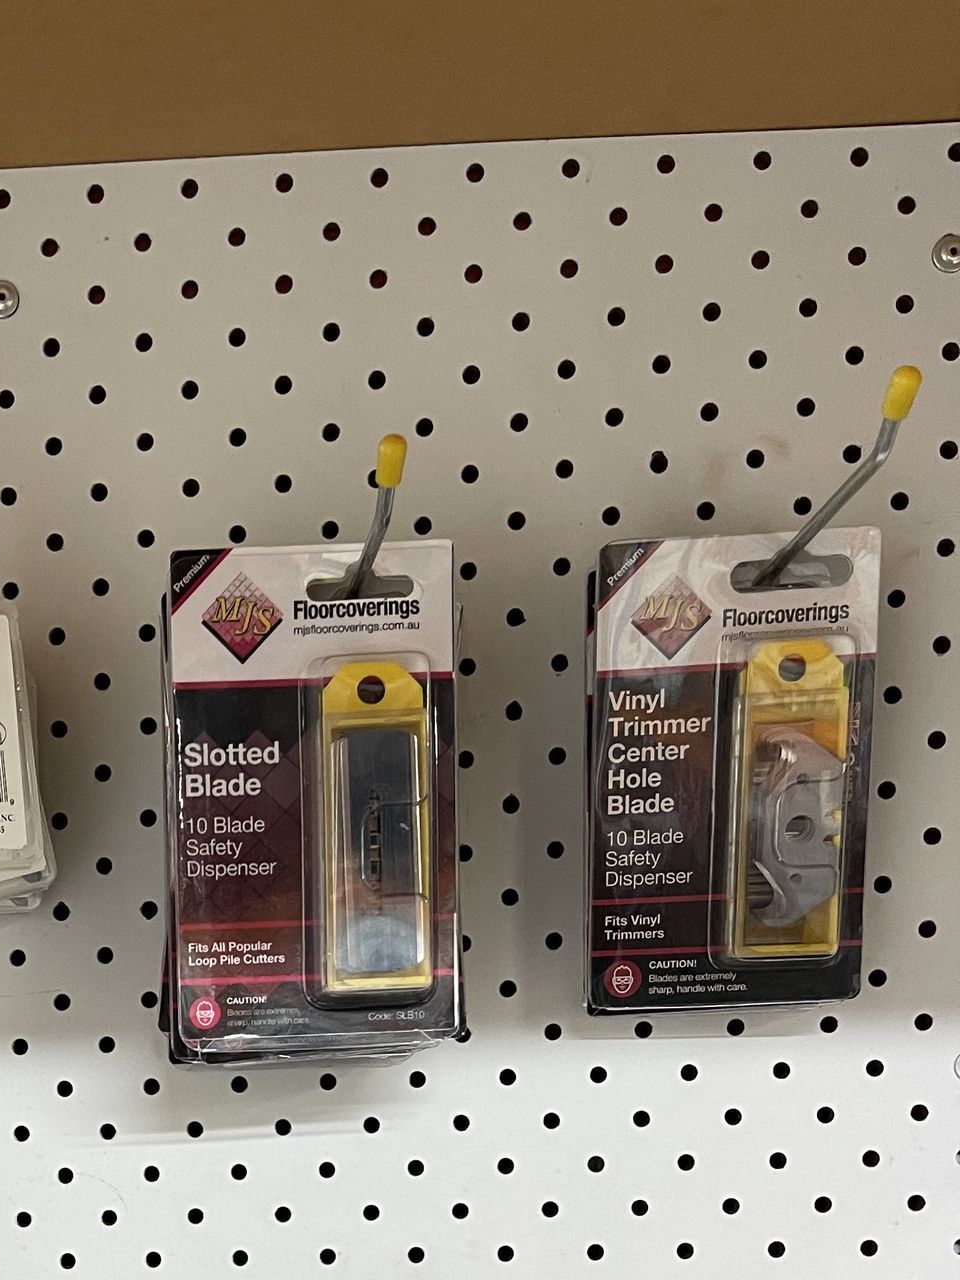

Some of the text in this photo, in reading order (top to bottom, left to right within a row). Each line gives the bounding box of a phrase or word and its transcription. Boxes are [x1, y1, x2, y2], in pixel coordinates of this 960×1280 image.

[173, 555, 211, 592] Premium
[607, 547, 644, 586] Premium
[212, 596, 276, 635] MJS
[294, 598, 420, 619] Floorcoverings
[640, 593, 703, 631] MJS
[722, 602, 849, 627] Floorcoverings
[294, 621, 420, 636] mjsfloorcoverings.com.au
[609, 688, 665, 713] Vinyl
[608, 716, 711, 737] Trimmer
[184, 741, 280, 767] Slotted
[608, 743, 690, 764] Center
[185, 773, 261, 797] Blade
[608, 768, 662, 789] Hole
[607, 793, 675, 815] Blade
[187, 816, 265, 834] 10 Blade
[607, 829, 684, 847] 10 Blade
[187, 839, 243, 859] Safety
[605, 850, 661, 869] Safety
[187, 861, 277, 880] Dispenser
[605, 871, 693, 889] Dispenser
[605, 914, 660, 927] Fits Vinyl
[604, 929, 664, 940] Trimmers
[188, 941, 272, 953] Fits All Popular
[189, 954, 285, 967] Loop Pile Cutters
[649, 959, 697, 969] CAUTION!
[649, 974, 678, 983] Blades
[695, 972, 737, 981] extremely
[649, 983, 748, 995] sharp, handle with care.
[227, 996, 267, 1004] CAUTION!
[396, 1010, 425, 1019] SLB10
